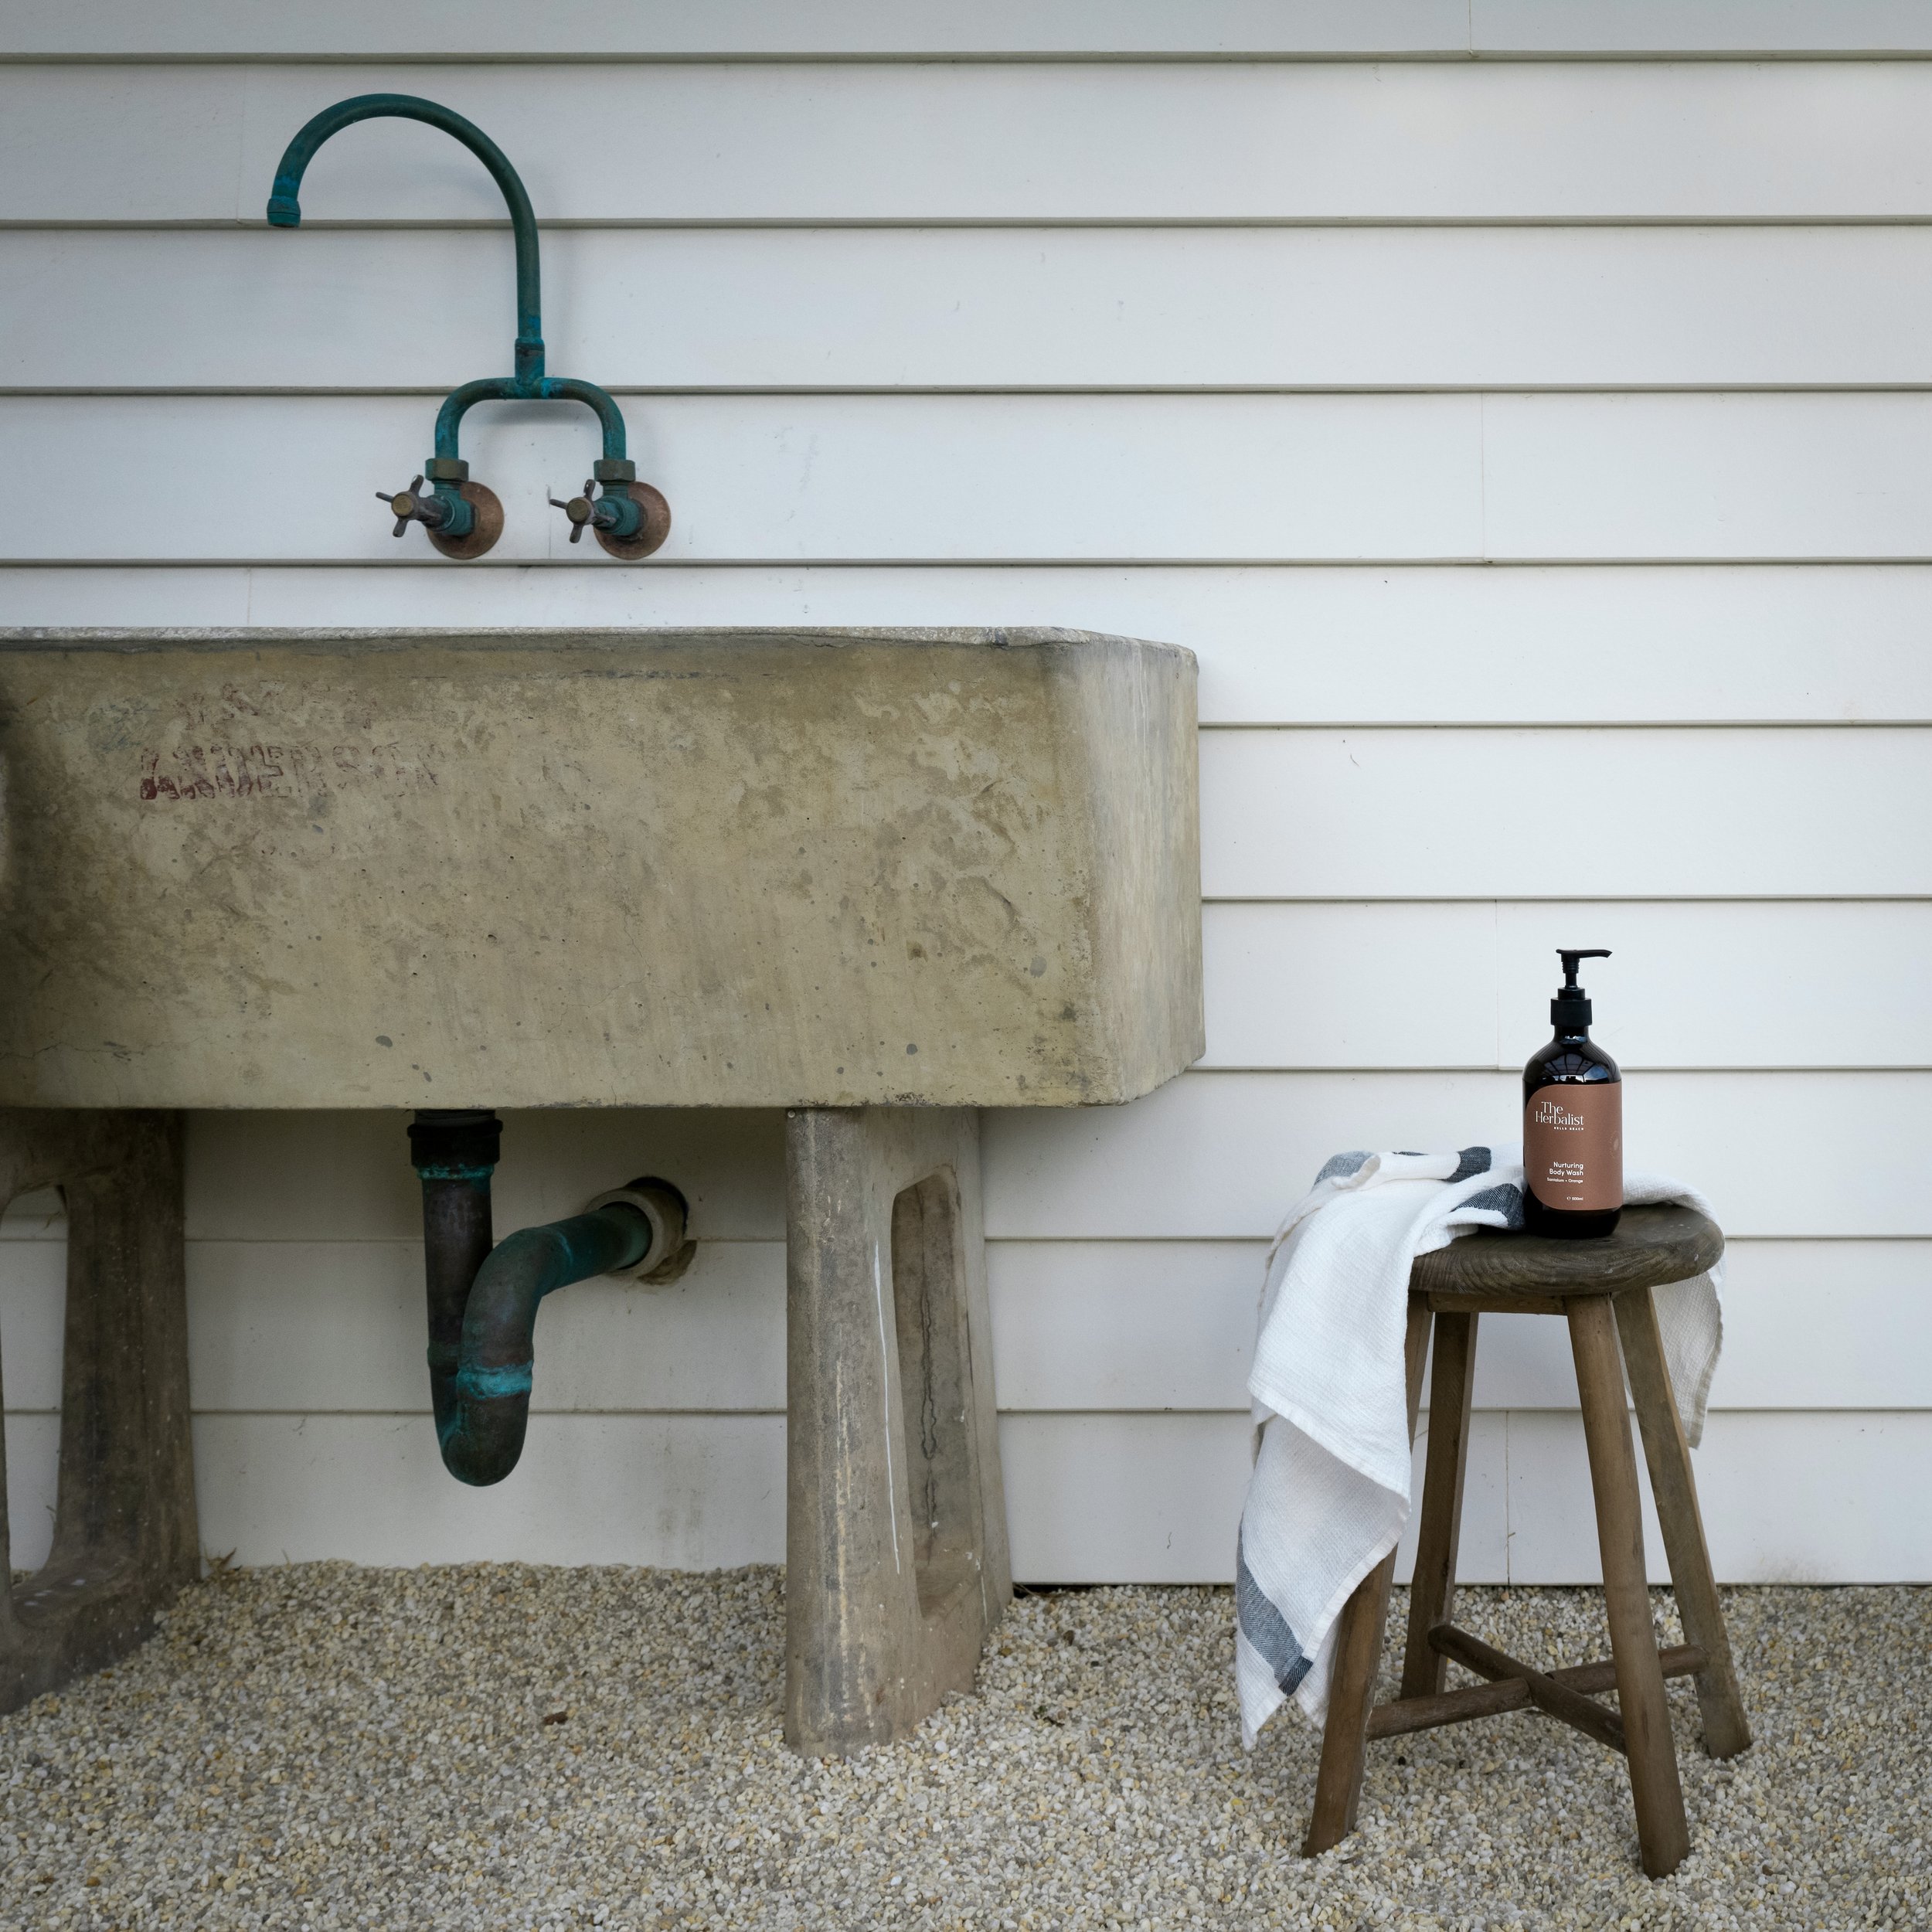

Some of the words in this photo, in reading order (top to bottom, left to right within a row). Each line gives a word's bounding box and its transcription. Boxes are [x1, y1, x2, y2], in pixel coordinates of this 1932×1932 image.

[1541, 1101, 1563, 1114] The
[1536, 1111, 1584, 1126] Herbalist
[1553, 1162, 1583, 1170] Nurturing
